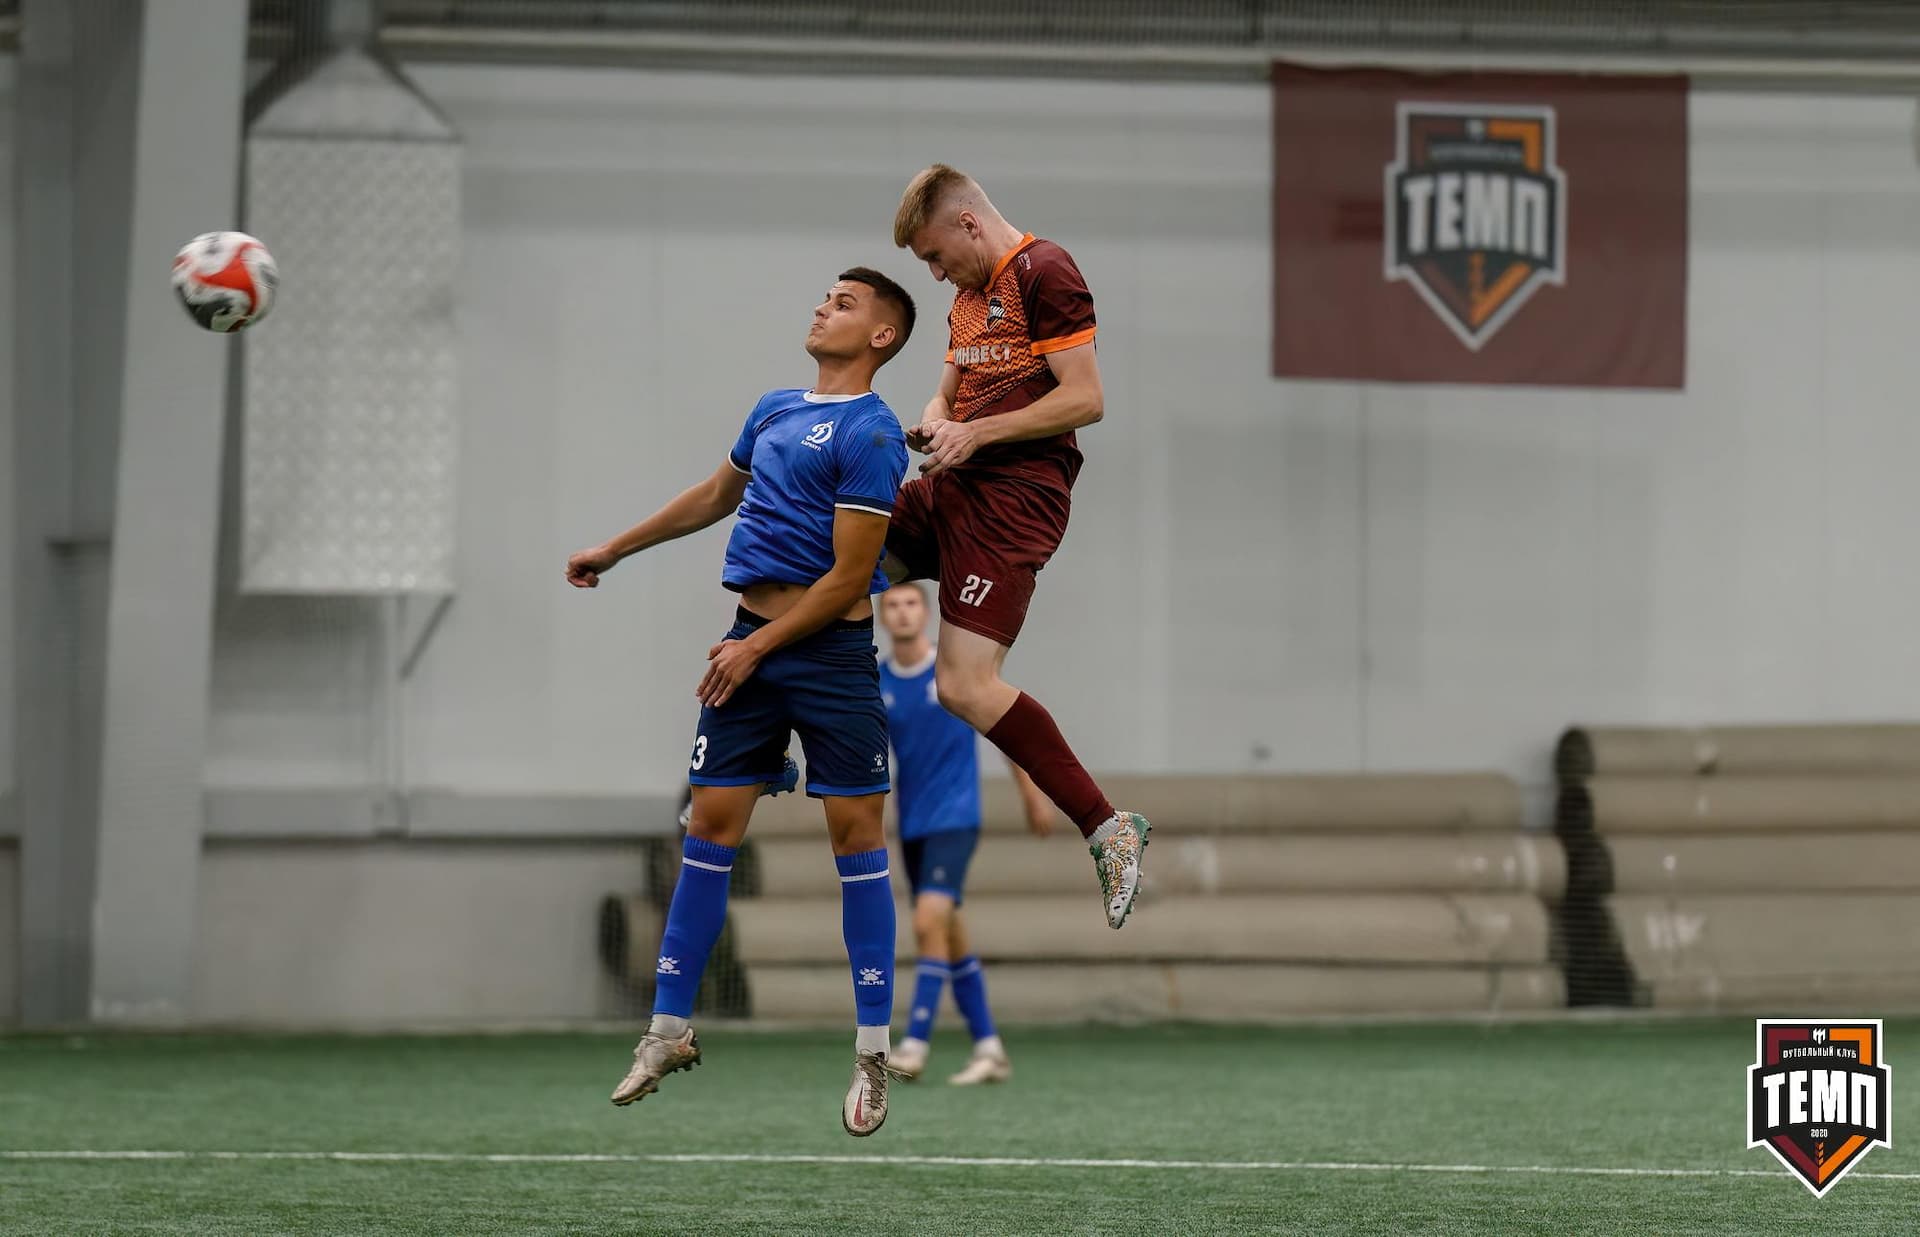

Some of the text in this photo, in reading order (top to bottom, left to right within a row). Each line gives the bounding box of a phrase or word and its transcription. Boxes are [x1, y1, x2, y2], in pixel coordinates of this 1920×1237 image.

[1403, 171, 1548, 260] ТЕМП
[959, 574, 994, 607] 27
[692, 735, 708, 770] 3
